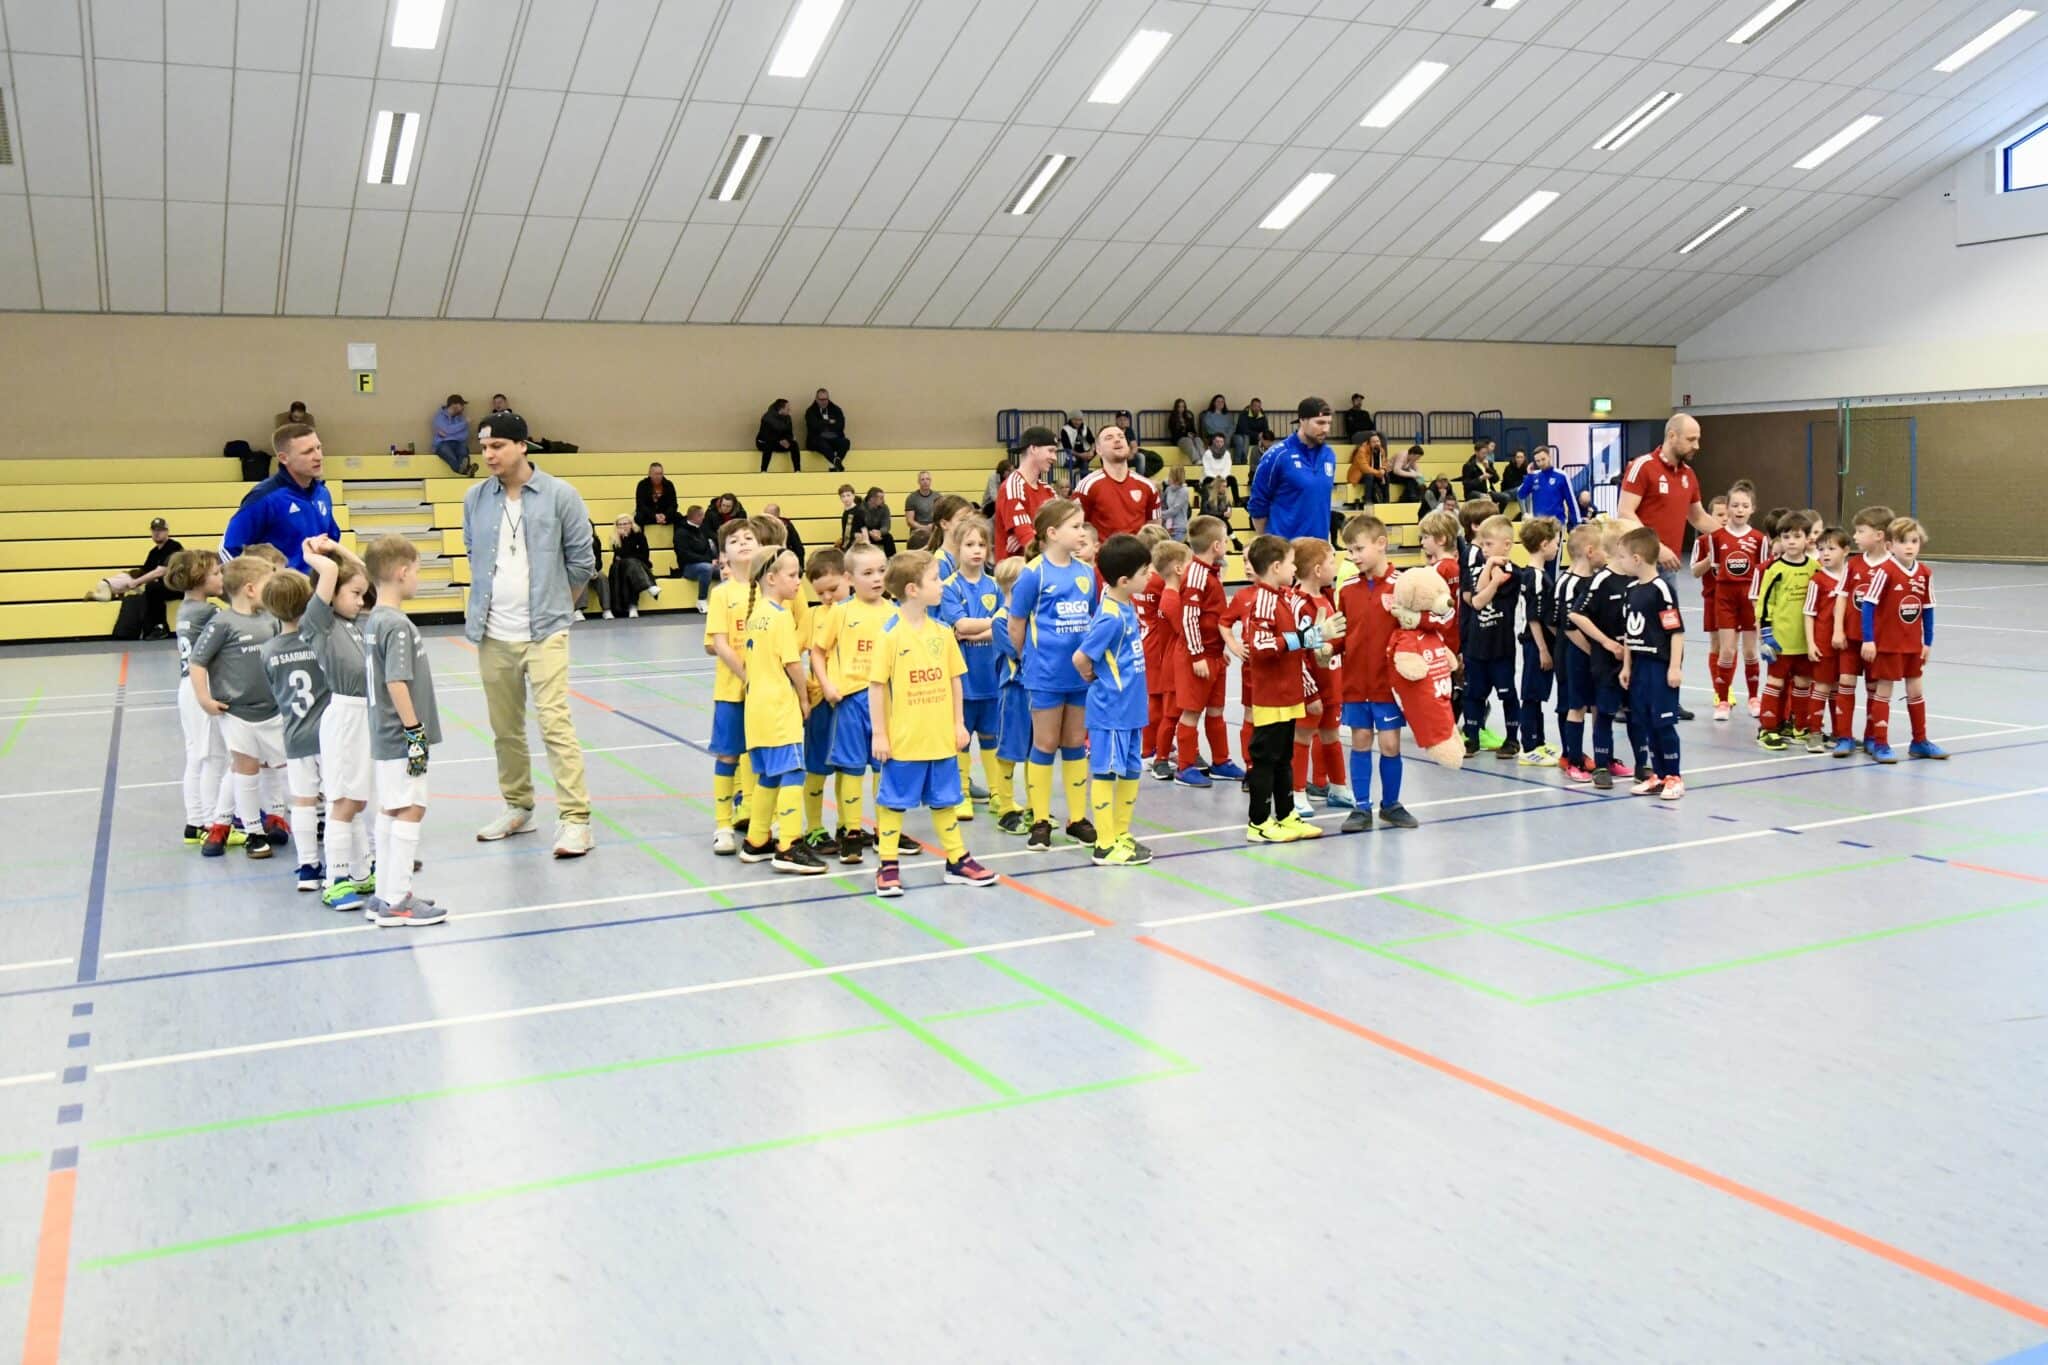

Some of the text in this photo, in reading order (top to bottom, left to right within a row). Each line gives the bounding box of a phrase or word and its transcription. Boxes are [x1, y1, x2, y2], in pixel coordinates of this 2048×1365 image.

[359, 374, 370, 391] F
[1055, 600, 1090, 616] ERGO
[280, 649, 317, 665] SAARMUN
[909, 667, 943, 684] ERGO
[288, 669, 315, 719] 3
